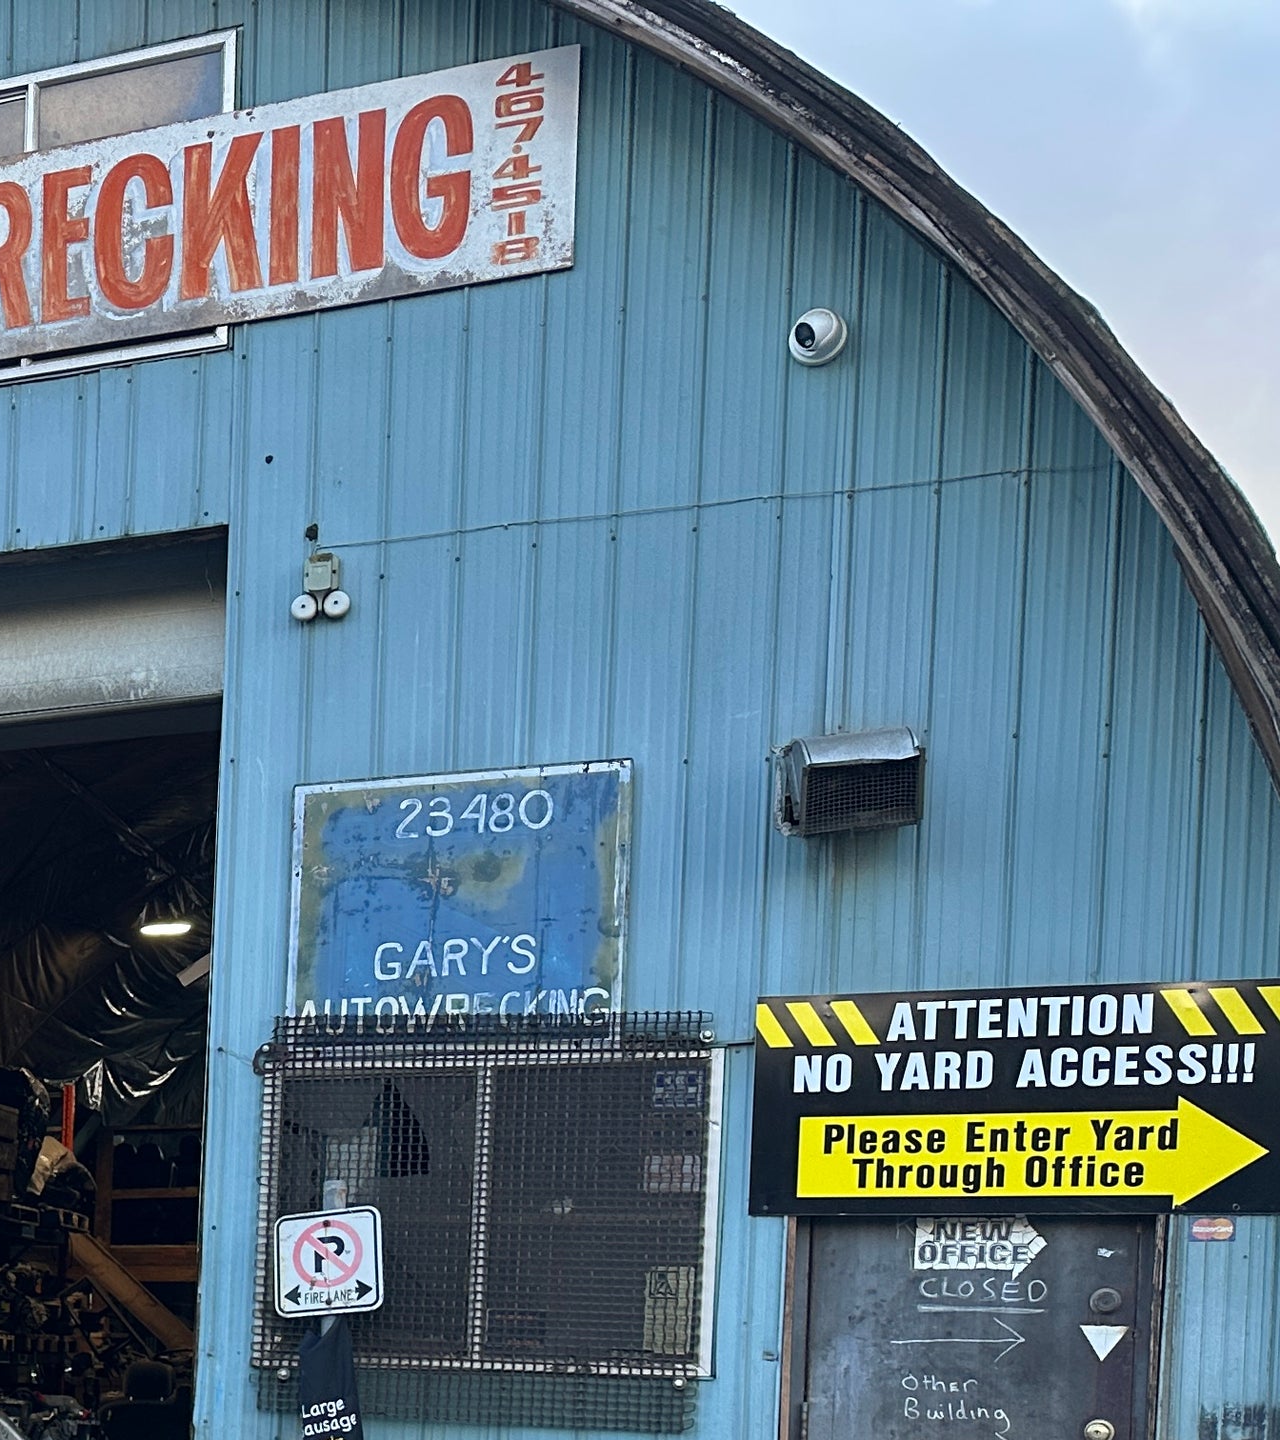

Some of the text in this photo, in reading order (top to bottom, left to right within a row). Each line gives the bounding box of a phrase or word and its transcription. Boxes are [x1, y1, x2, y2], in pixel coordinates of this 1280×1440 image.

[395, 789, 554, 840] 23480
[373, 933, 537, 981] GARY'S
[886, 993, 1155, 1042] ATTENTION
[793, 1043, 1256, 1094] NO YARD ACCESS!!!
[823, 1118, 1180, 1155] Please Enter Yard
[852, 1155, 1145, 1194] Through Office
[934, 1220, 1012, 1241] NEW
[918, 1242, 1030, 1263] OFFICE
[304, 1291, 325, 1304] FIRE
[919, 1277, 1047, 1302] CLOSED
[301, 1399, 345, 1419] Large
[302, 1413, 357, 1437] ausage
[903, 1396, 1012, 1435] Building
